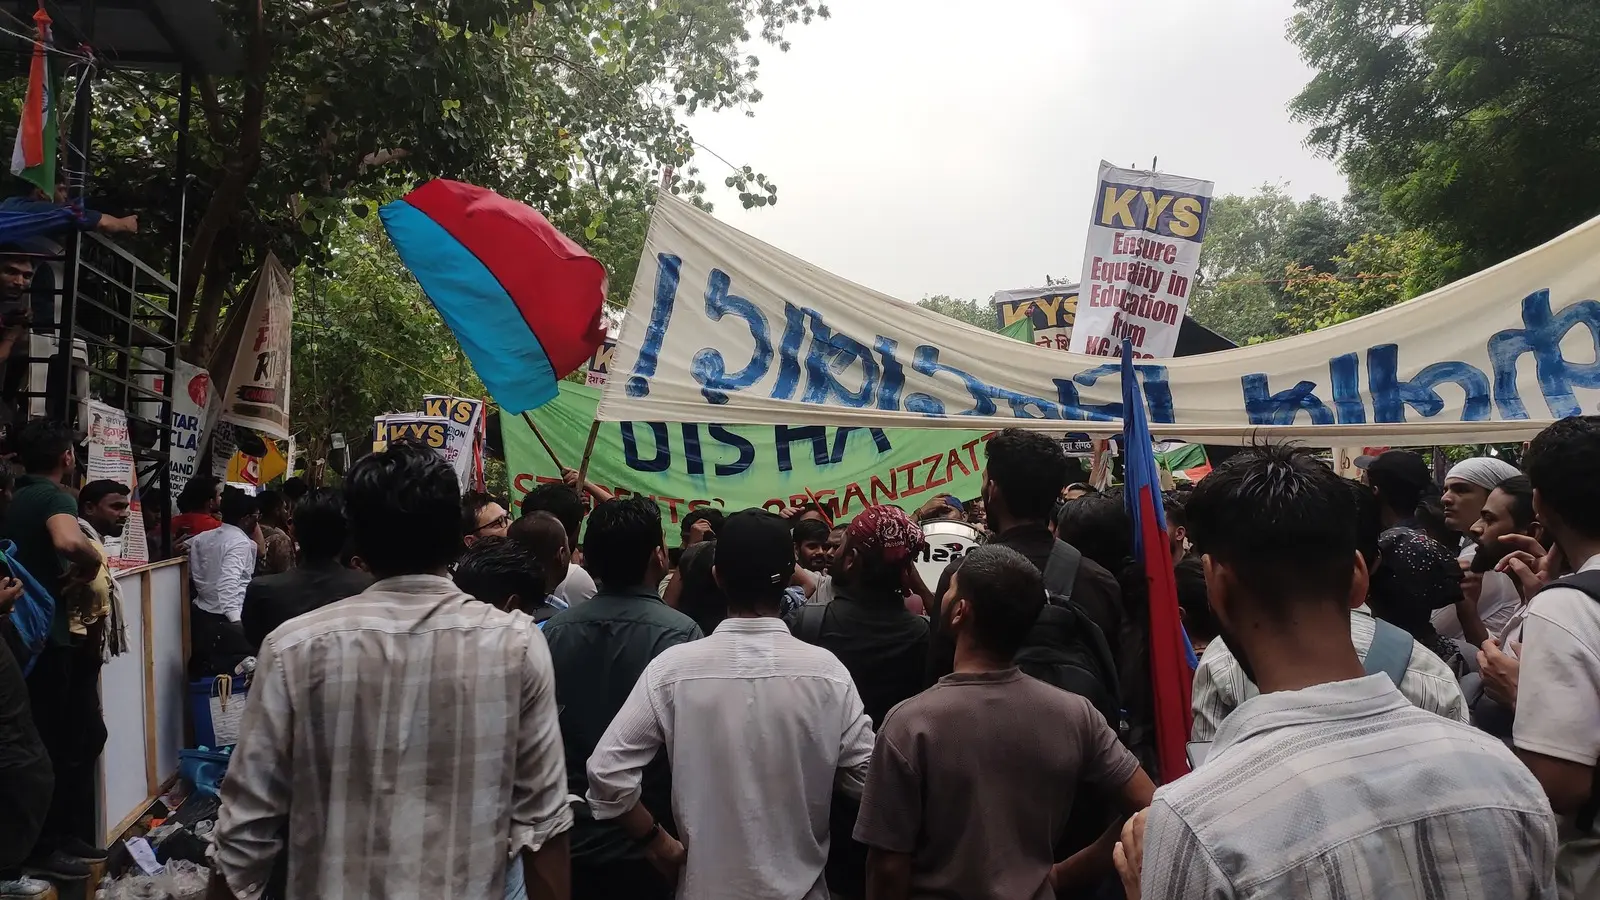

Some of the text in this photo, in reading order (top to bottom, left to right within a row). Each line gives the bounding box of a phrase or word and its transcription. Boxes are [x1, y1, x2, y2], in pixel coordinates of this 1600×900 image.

[1101, 186, 1203, 239] KYS
[1112, 231, 1178, 265] Ensure
[1090, 255, 1189, 299] Equality in
[1089, 283, 1179, 326] Education
[1110, 310, 1147, 348] from
[426, 398, 473, 423] KYS
[390, 424, 445, 448] KYS
[620, 420, 892, 477] DISHA
